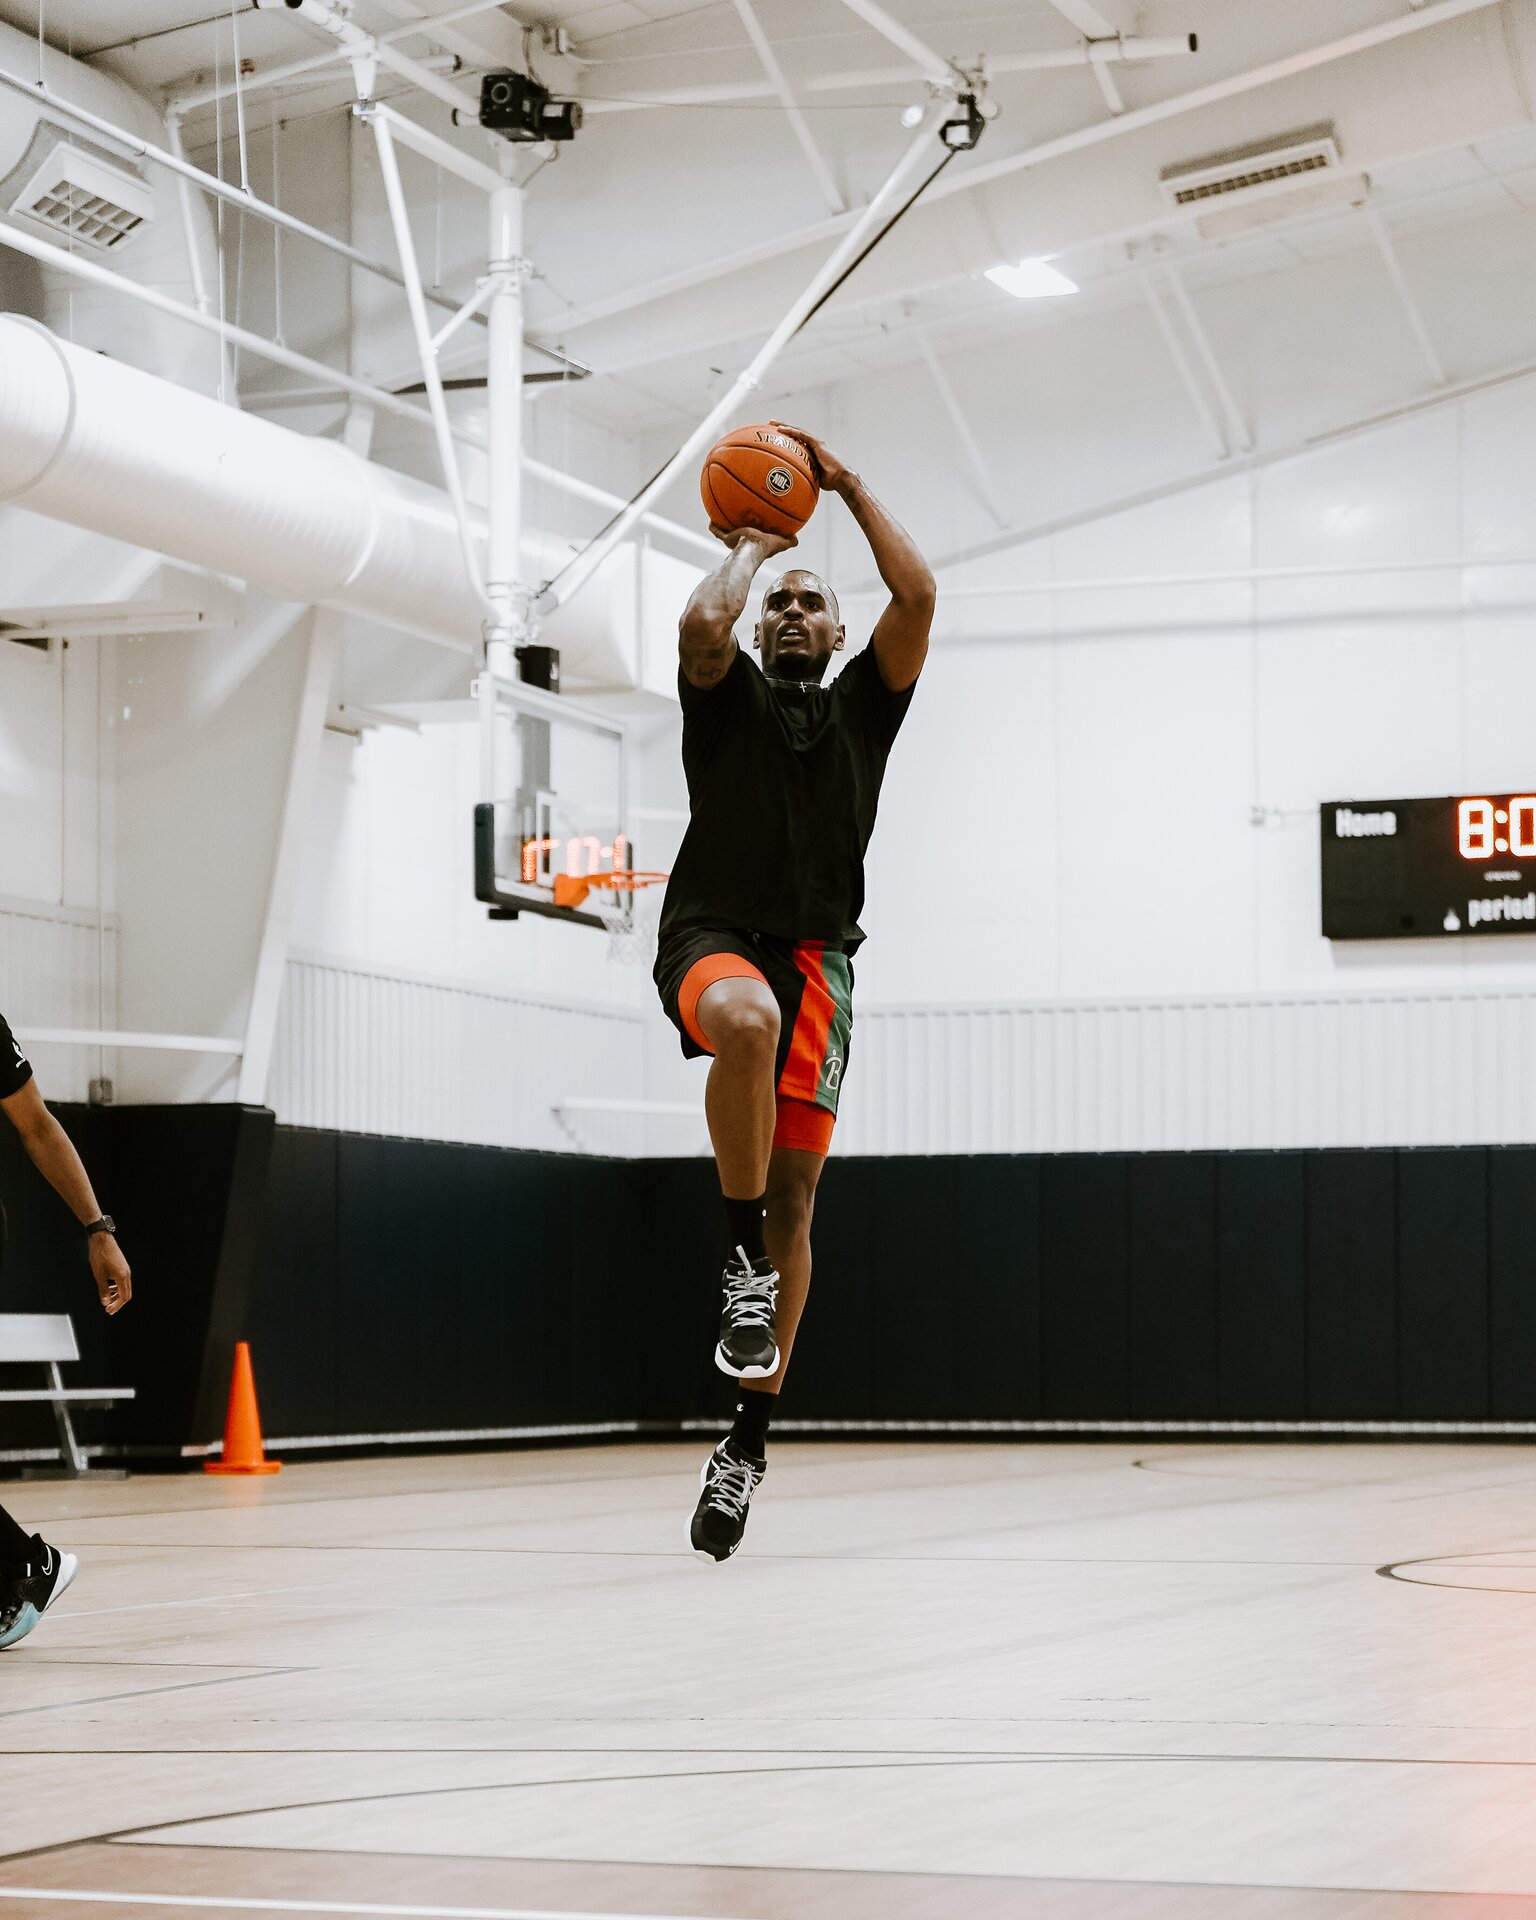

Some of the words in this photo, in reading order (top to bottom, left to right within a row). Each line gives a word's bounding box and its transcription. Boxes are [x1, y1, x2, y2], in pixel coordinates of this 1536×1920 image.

[771, 473, 788, 490] NBL
[1335, 808, 1397, 838] Home
[1468, 892, 1536, 928] period
